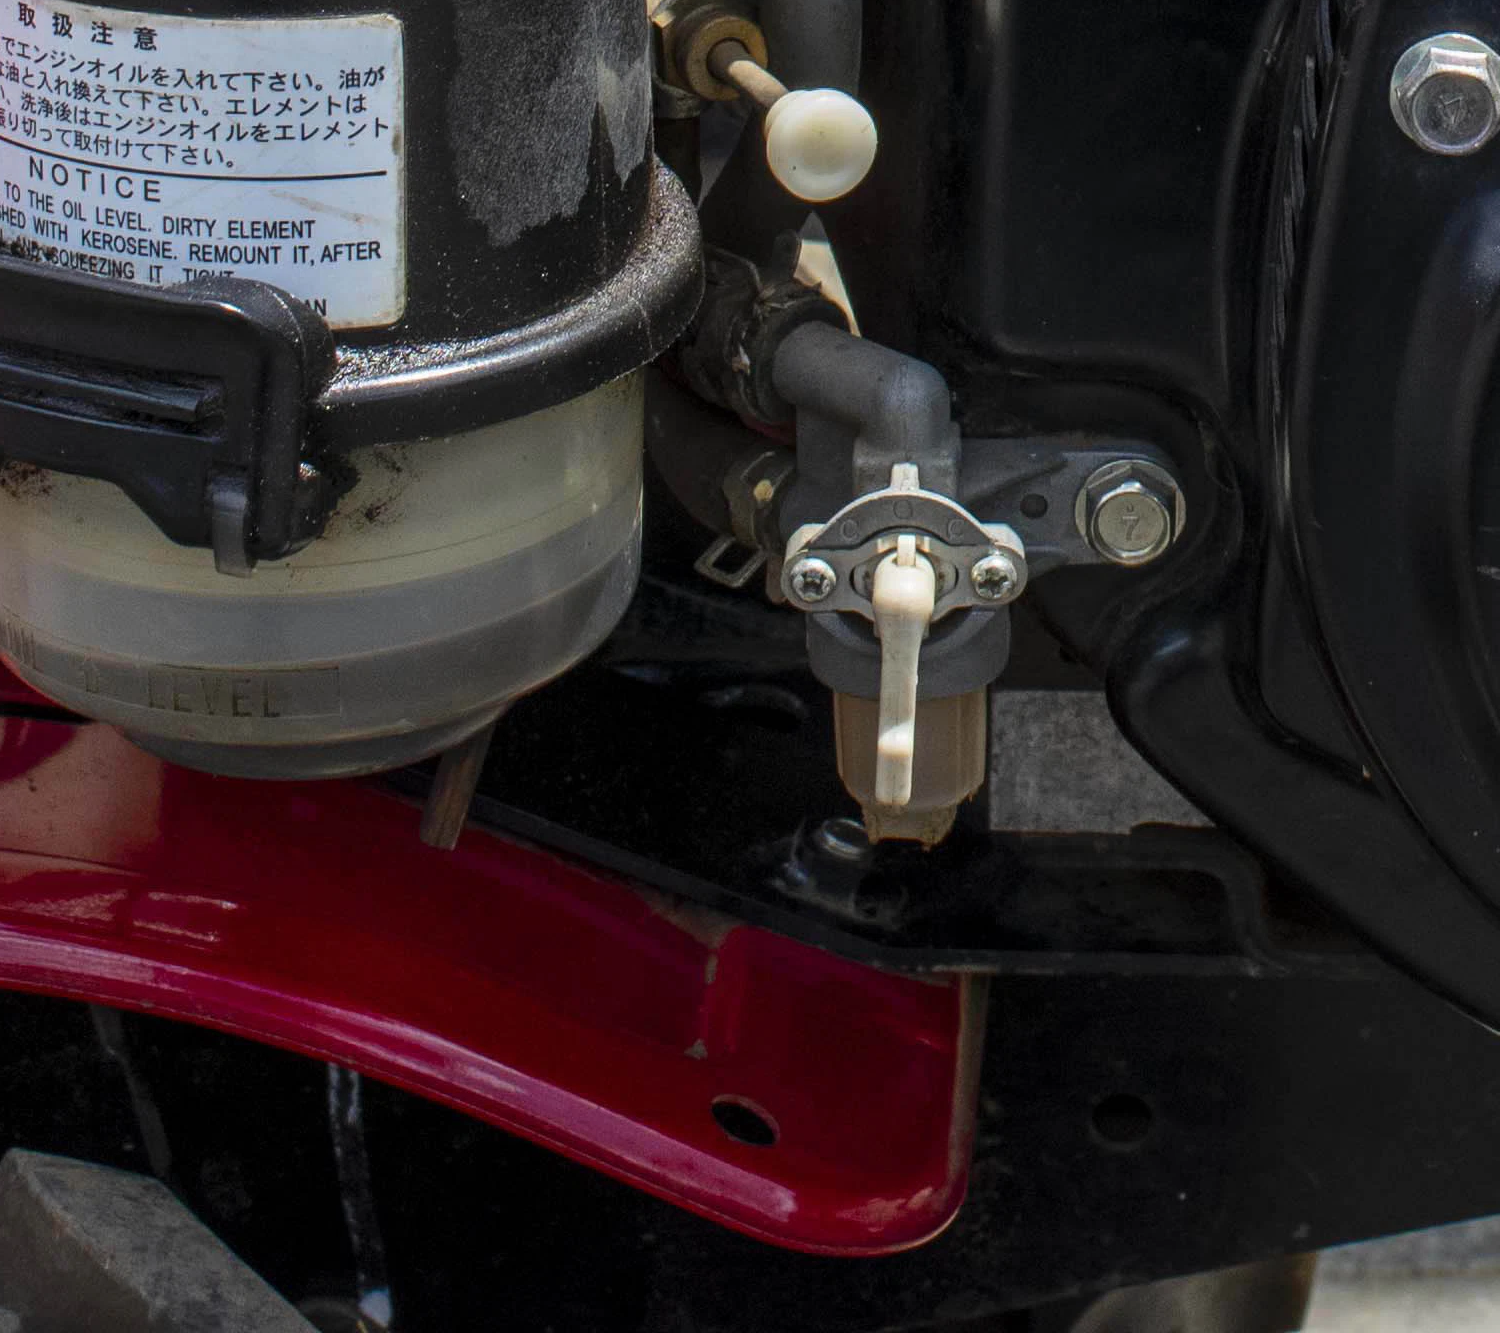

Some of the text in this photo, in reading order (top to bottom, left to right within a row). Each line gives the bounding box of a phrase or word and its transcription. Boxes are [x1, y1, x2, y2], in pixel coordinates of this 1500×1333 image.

[17, 1, 159, 52] 取扱注意
[28, 155, 162, 203] NOTICE
[4, 180, 21, 204] TO
[27, 189, 55, 215] THE
[62, 199, 88, 222] OIL
[95, 205, 152, 233] LEVEL.
[162, 215, 218, 238] DIRTY
[227, 219, 317, 240] ELEMENT
[33, 215, 69, 243] WITH
[81, 229, 178, 261] KEROSENE.
[189, 243, 282, 265] REMOUNT
[320, 241, 382, 264] AFTER
[51, 245, 135, 280] SQUEEZING
[149, 264, 164, 283] IT
[147, 670, 282, 718] LEVEL
